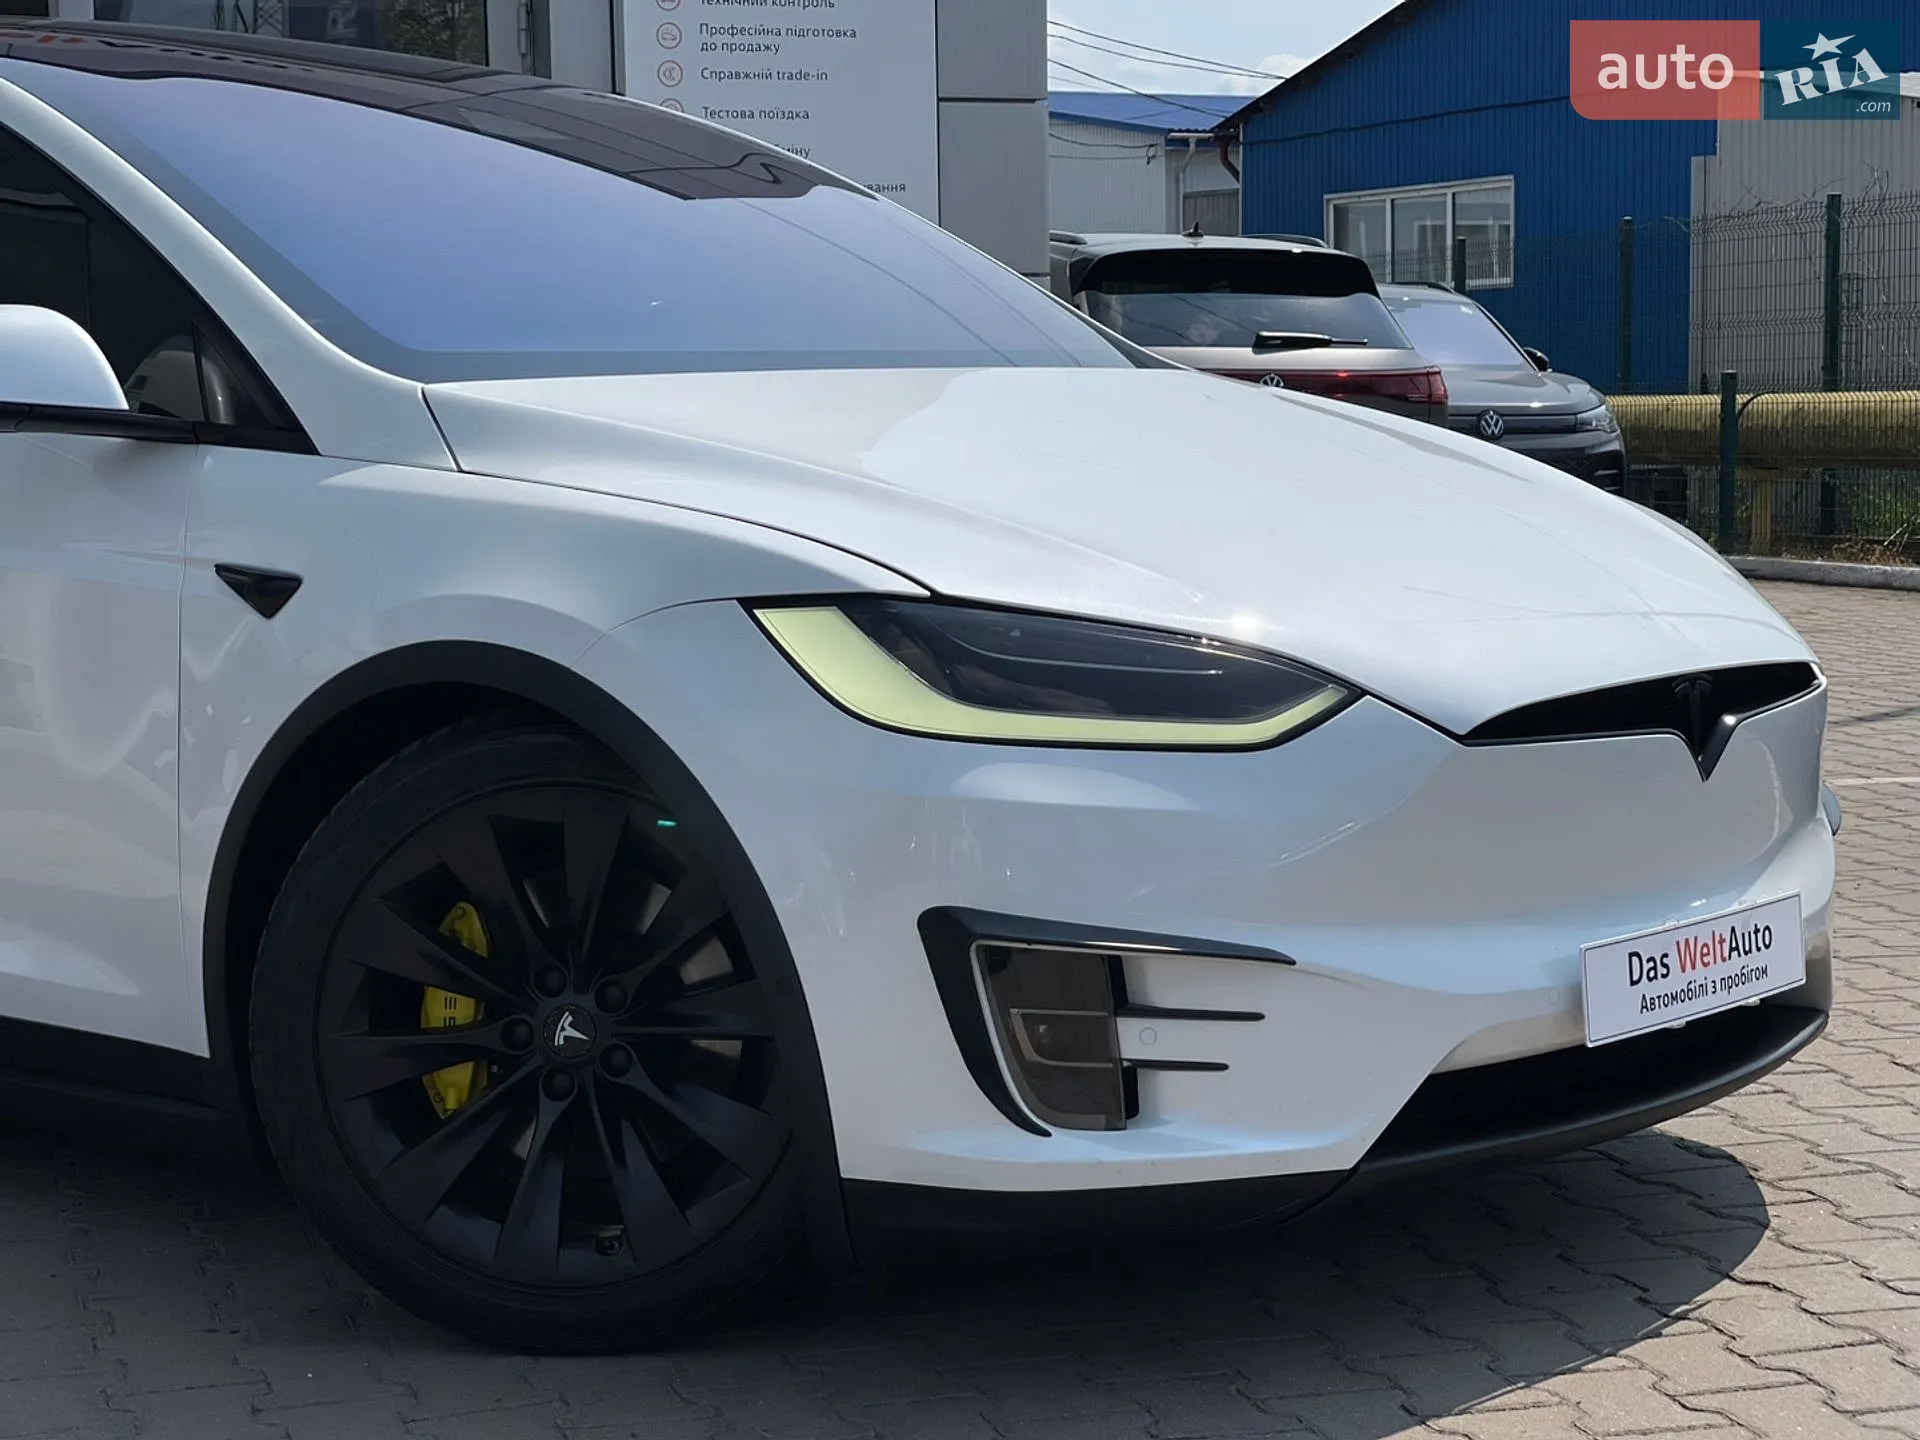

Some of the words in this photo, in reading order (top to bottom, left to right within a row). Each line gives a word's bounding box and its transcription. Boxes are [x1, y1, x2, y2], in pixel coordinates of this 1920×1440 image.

[771, 0, 836, 11] контроль
[699, 23, 782, 38] Професійна
[786, 25, 857, 38] підготовка
[700, 42, 718, 52] до
[721, 42, 781, 55] продажу
[700, 67, 773, 82] Справжній
[776, 69, 828, 81] trade-in
[702, 106, 755, 119] Тестова
[758, 107, 810, 121] поїздка
[1627, 950, 1671, 987] Das
[1675, 923, 1773, 974] WeltAuto
[1639, 976, 1708, 1014] Автомобілі
[1711, 982, 1718, 995] з
[1719, 963, 1769, 995] пробігом
